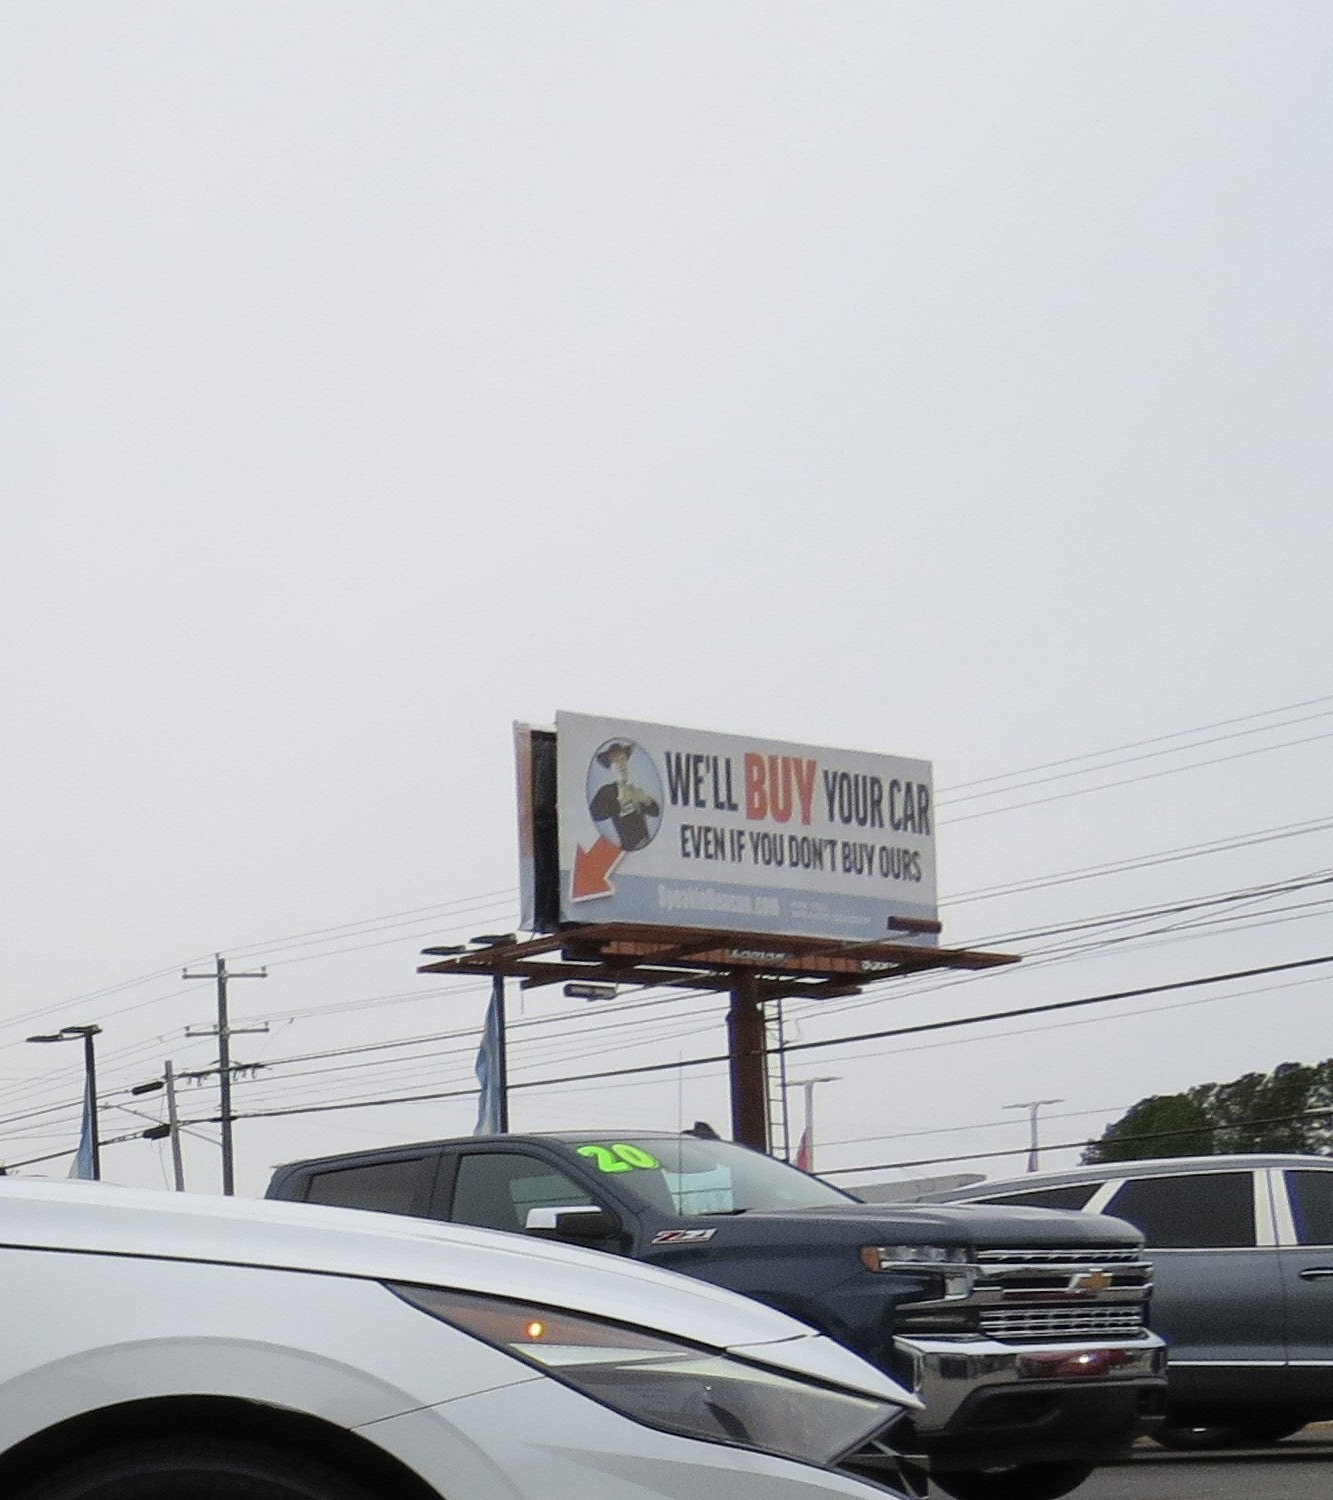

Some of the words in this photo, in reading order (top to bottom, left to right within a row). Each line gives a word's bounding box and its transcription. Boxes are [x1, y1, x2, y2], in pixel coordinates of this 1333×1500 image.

[665, 752, 738, 811] WE'LL
[744, 752, 817, 825] BUY
[822, 769, 884, 828] YOUR
[889, 779, 931, 836] CAR
[680, 824, 725, 861] EVEN
[730, 829, 745, 863] IF
[749, 831, 784, 866] YOU
[788, 834, 838, 872] DON'T
[841, 840, 876, 876] BUY
[879, 845, 922, 883] OURS
[577, 1143, 661, 1172] 20
